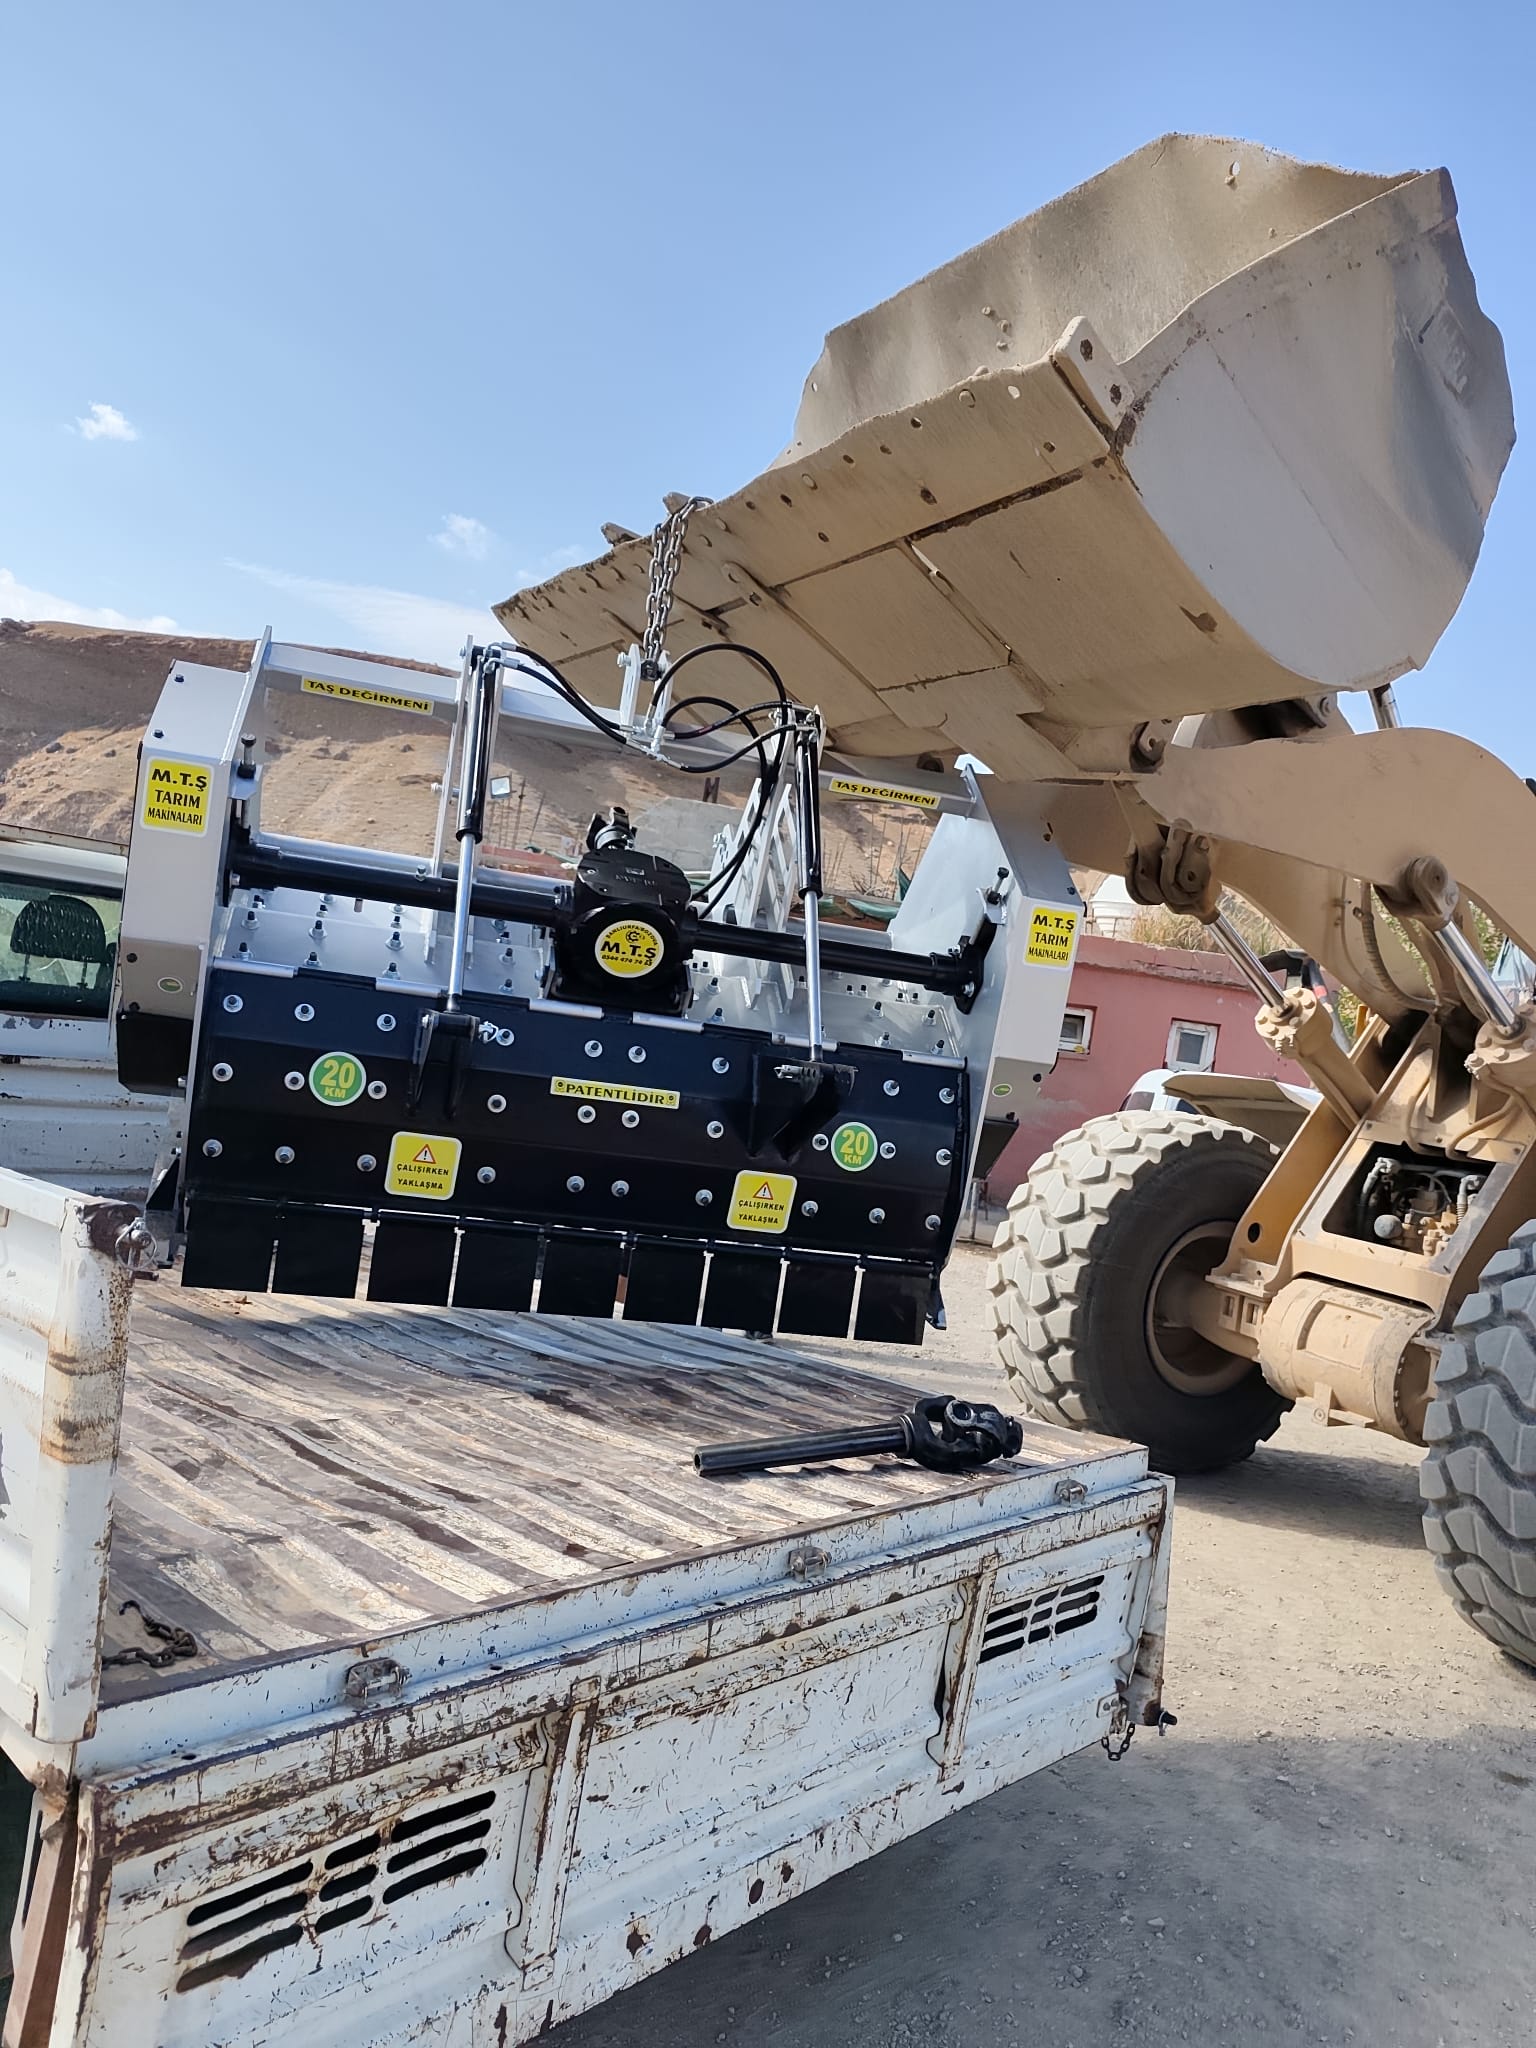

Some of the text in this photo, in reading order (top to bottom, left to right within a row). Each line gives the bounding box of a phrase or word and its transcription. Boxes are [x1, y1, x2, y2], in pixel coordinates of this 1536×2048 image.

[308, 680, 428, 711] TAŞ DEĞİRMENİ
[151, 768, 208, 792] M.T.Ş
[154, 789, 201, 809] TARIM
[836, 781, 936, 806] TAŞ DEĞİRMENİ
[1033, 914, 1075, 933] M.T.Ş
[1035, 931, 1069, 948] TARIM
[320, 1059, 356, 1089] 20
[324, 1086, 347, 1099] KM
[566, 1083, 665, 1105] PATENTLİDİR
[840, 1129, 869, 1156] 20
[843, 1153, 862, 1165] KM
[396, 1163, 449, 1176] ÇALIŞIRKEN
[397, 1178, 443, 1190] YAKLAŞMA
[738, 1200, 785, 1212] ÇALIŞIRKEN
[738, 1213, 779, 1225] YAKLAŞMA
